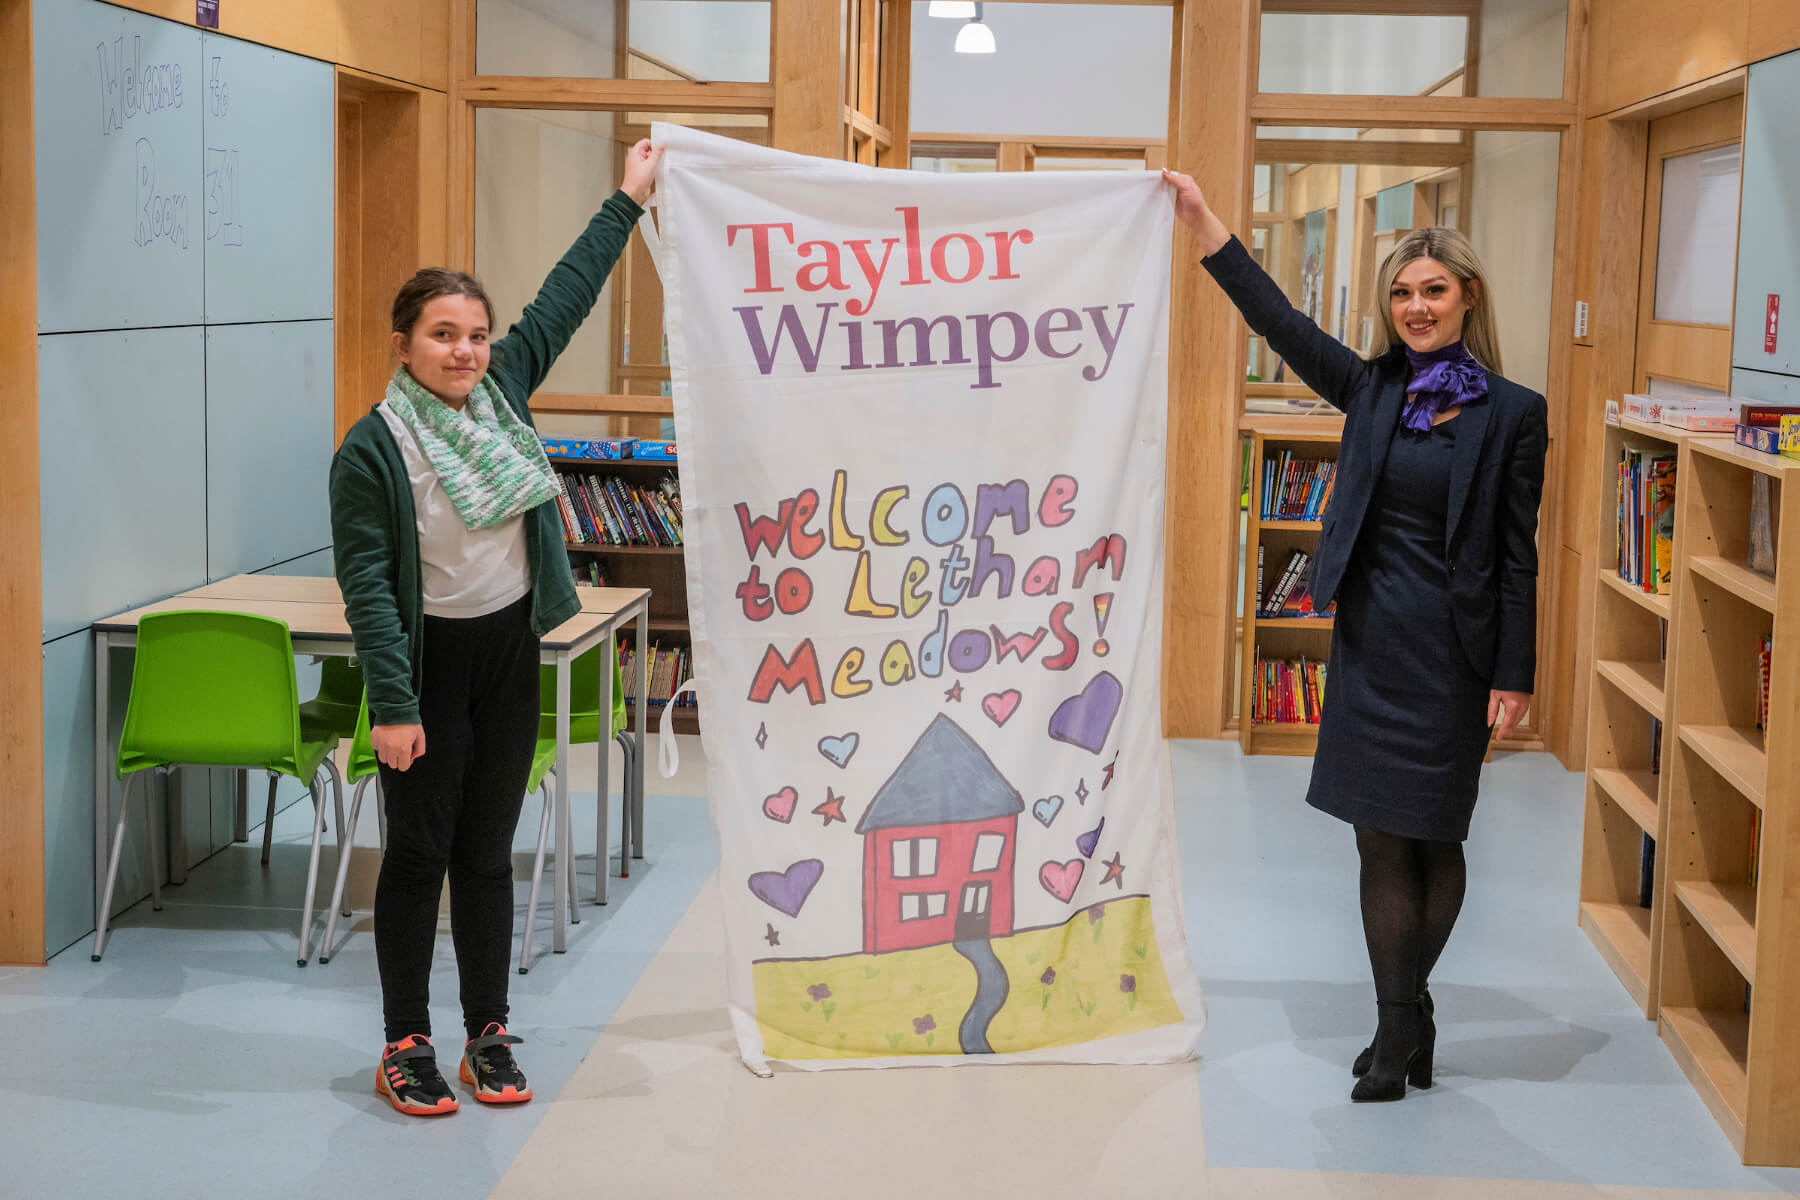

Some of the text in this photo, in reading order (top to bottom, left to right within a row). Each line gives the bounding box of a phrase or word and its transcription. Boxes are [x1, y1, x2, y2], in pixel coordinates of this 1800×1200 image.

[97, 35, 229, 136] Welcome to
[134, 137, 242, 249] Room 31
[726, 206, 1034, 317] Taylor
[732, 302, 1135, 389] Wimpey
[844, 533, 1127, 618] Letham
